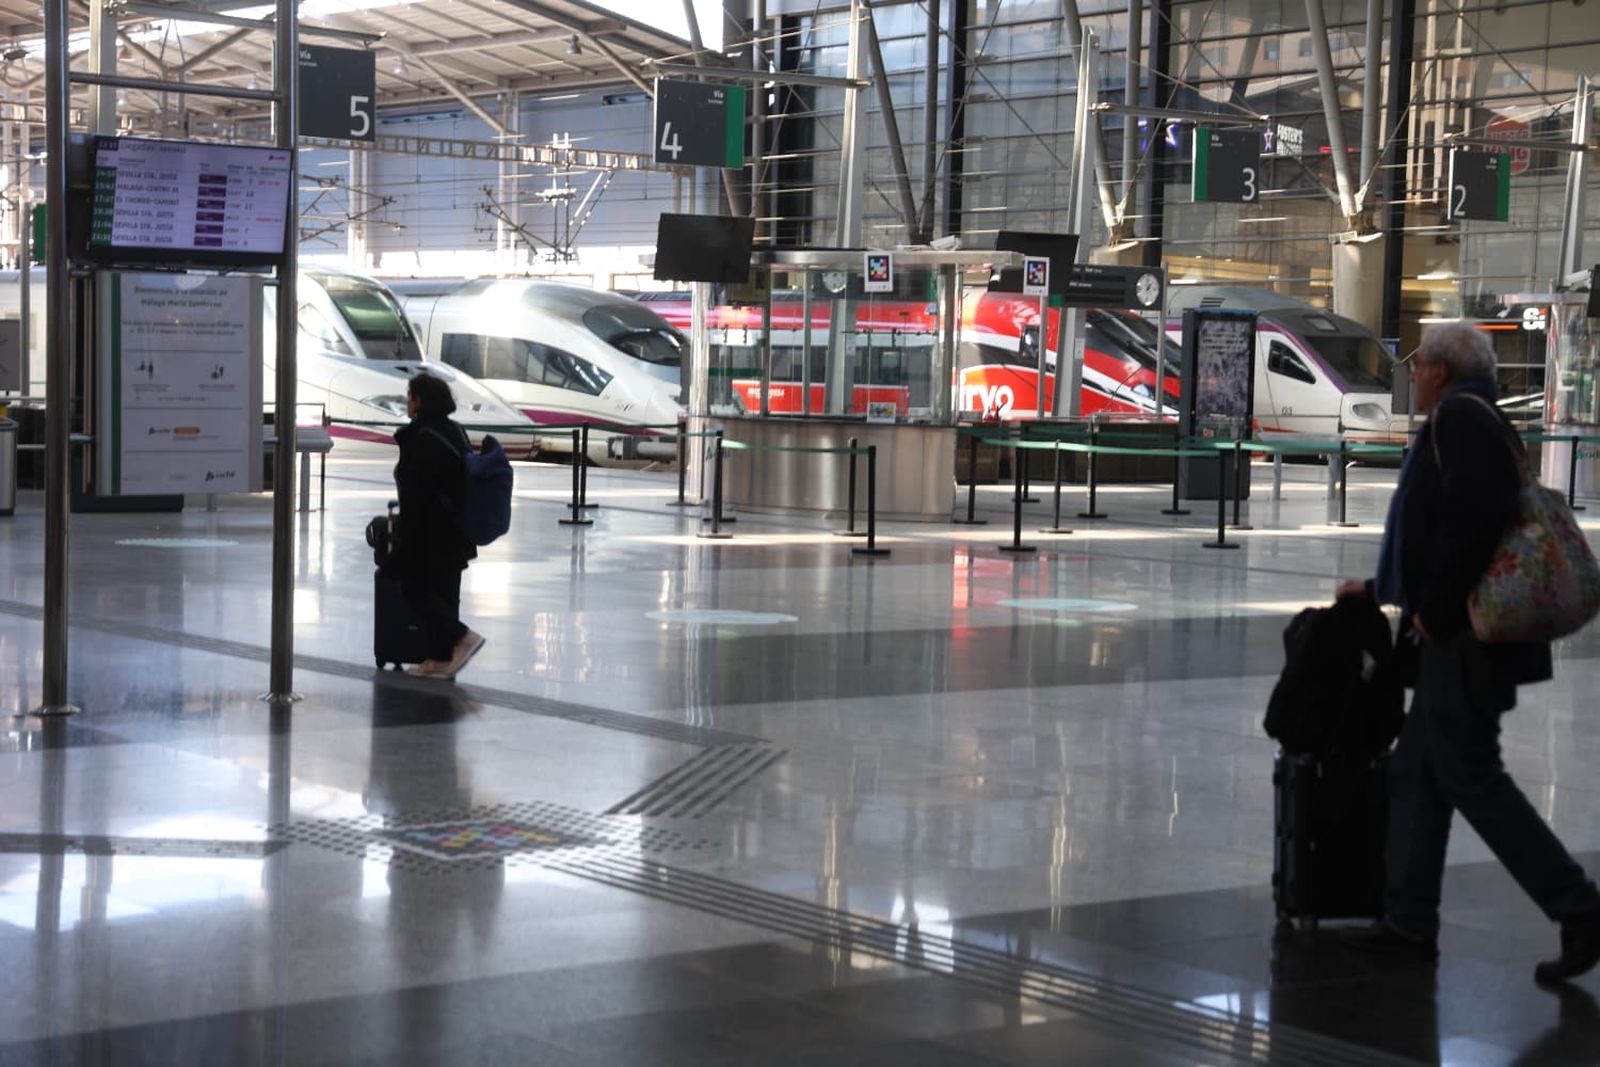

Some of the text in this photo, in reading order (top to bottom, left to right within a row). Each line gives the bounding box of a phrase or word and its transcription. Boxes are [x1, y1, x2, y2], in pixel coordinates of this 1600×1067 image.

[349, 95, 370, 137] 5
[660, 121, 683, 160] 4
[1241, 167, 1256, 201] 3
[1453, 184, 1467, 216] 2
